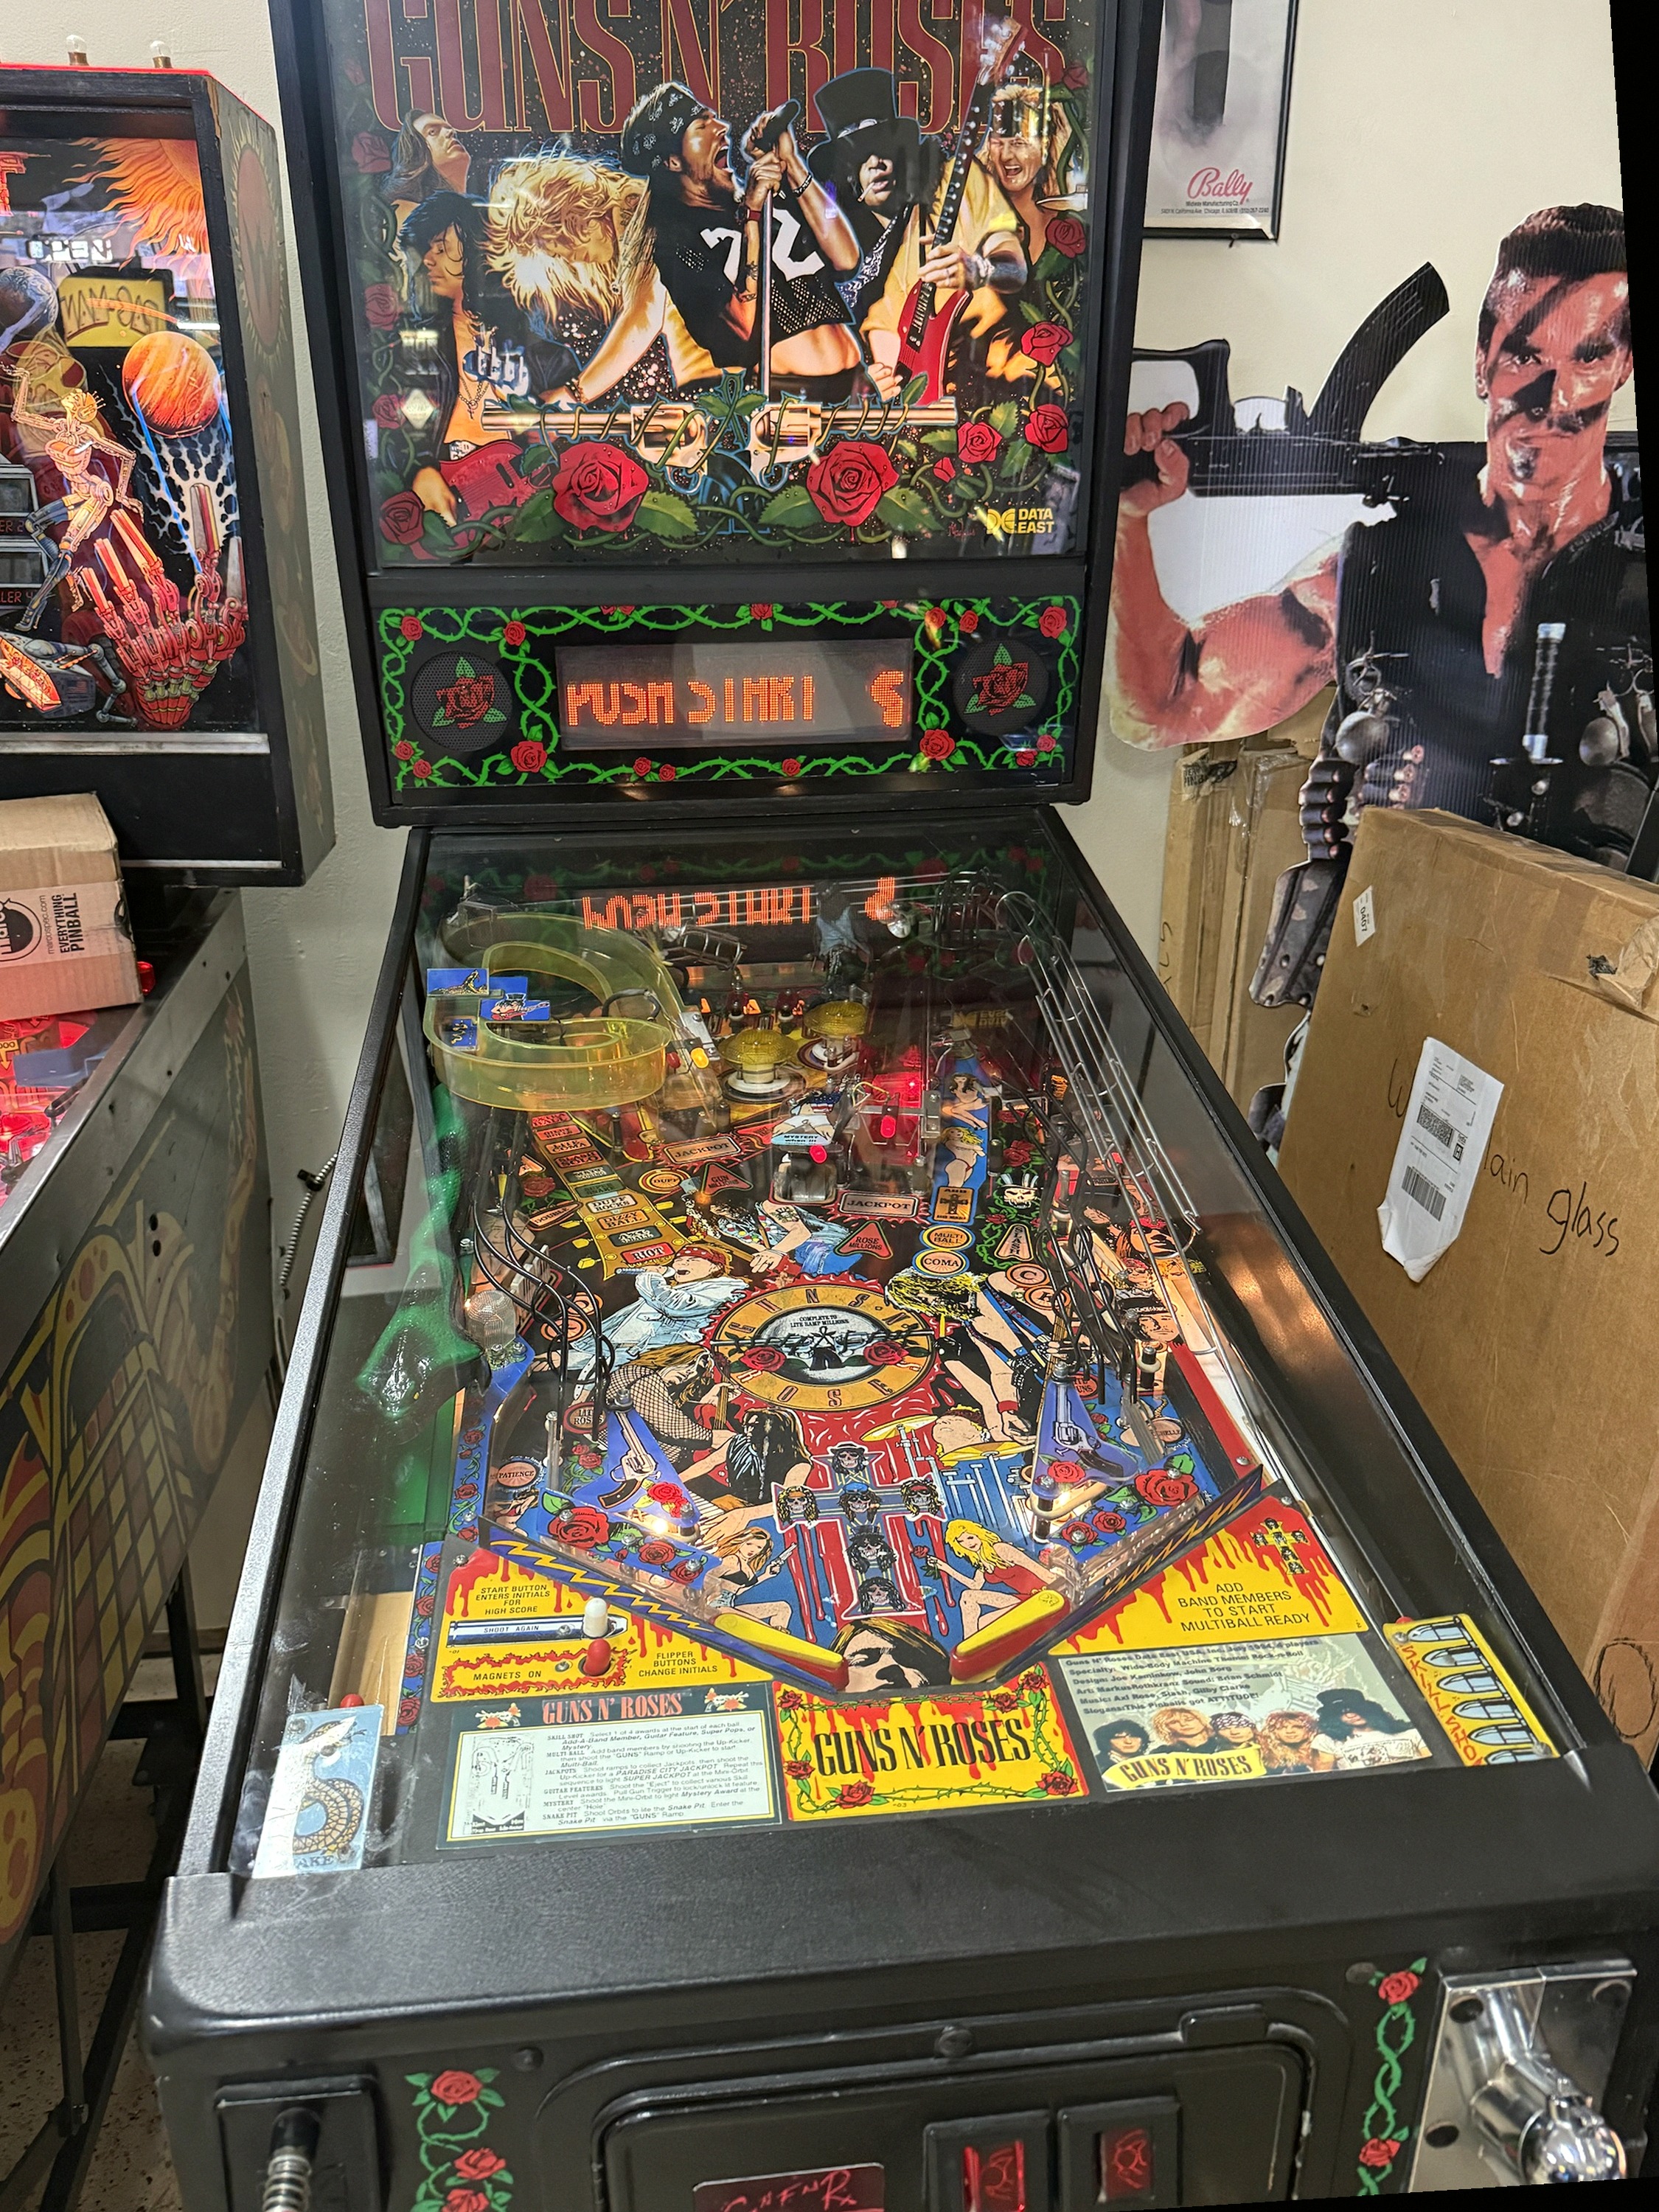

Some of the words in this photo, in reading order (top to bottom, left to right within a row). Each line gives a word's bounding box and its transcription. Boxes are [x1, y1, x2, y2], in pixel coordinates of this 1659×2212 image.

[365, 0, 637, 133] GUNS
[1187, 167, 1253, 205] Bally
[1018, 507, 1053, 521] DATA
[1018, 521, 1054, 534] EAST
[52, 894, 70, 953] EVERYTHING
[63, 892, 85, 953] PINBALL
[675, 1143, 729, 1158] JACKPOT
[711, 1175, 729, 1183] GUN
[593, 1197, 626, 1206] DUFF
[596, 1201, 630, 1211] ROCKS
[847, 1200, 911, 1209] JACKPOT
[535, 1207, 569, 1223] DOUBLE
[604, 1212, 638, 1222] DIZZY
[1540, 1181, 1619, 1256] glass
[607, 1217, 642, 1228] BALL
[849, 1242, 882, 1251] MILLIONS
[855, 1237, 880, 1245] ROSE
[1011, 1226, 1023, 1256] SLASH
[632, 1247, 664, 1260] RIOT
[924, 1259, 959, 1267] COMA
[574, 1414, 603, 1425] ROSS
[498, 1470, 535, 1478] PATIENCE
[1216, 1582, 1243, 1593] ADD
[1178, 1596, 1218, 1607] BAND
[1221, 1590, 1291, 1604] MEMBERS
[1203, 1607, 1223, 1618] TO
[1228, 1604, 1276, 1615] START
[1181, 1617, 1262, 1632] MULTIBALL
[1265, 1613, 1310, 1625] READY
[656, 1652, 693, 1660] FLIPPER
[653, 1658, 696, 1667] BUTTONS
[473, 1672, 521, 1680] MAGNETS
[639, 1669, 676, 1677] CHANGE
[679, 1666, 717, 1674] INITIALS
[543, 1697, 593, 1724] GUNS
[598, 1697, 615, 1721] N'
[621, 1693, 683, 1719] ROSES
[814, 1728, 897, 1777] GUNS
[899, 1725, 926, 1769] N'
[931, 1717, 1032, 1767] ROSES
[1446, 1716, 1483, 1766] SHO
[680, 1764, 717, 1772] JACKPOT
[1120, 1757, 1172, 1782] GUNS
[1175, 1758, 1190, 1775] N'
[1193, 1755, 1253, 1777] ROSES
[653, 1772, 691, 1780] JACKPOT
